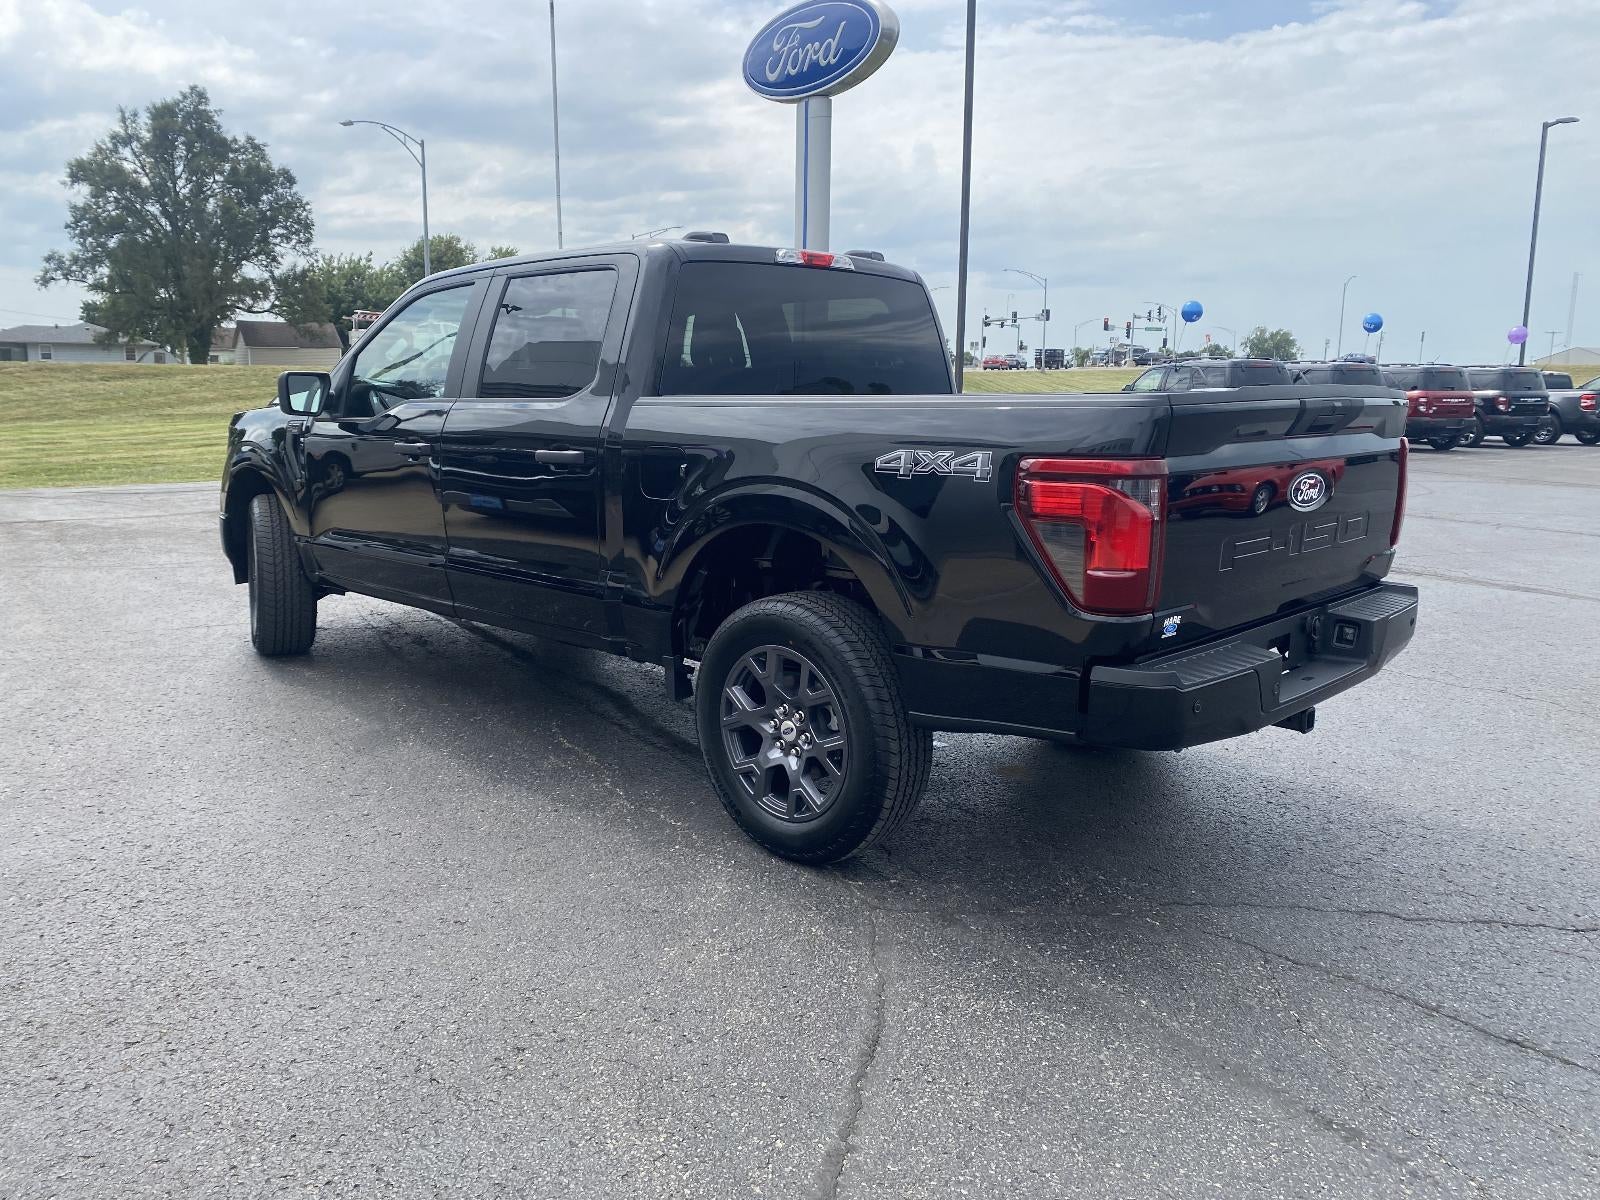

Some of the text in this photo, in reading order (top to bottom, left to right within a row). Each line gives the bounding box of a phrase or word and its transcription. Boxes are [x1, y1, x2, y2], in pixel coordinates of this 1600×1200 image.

[765, 15, 846, 82] Ford
[874, 449, 993, 482] 4X4
[1297, 478, 1321, 501] Ford
[1218, 512, 1369, 572] F-150
